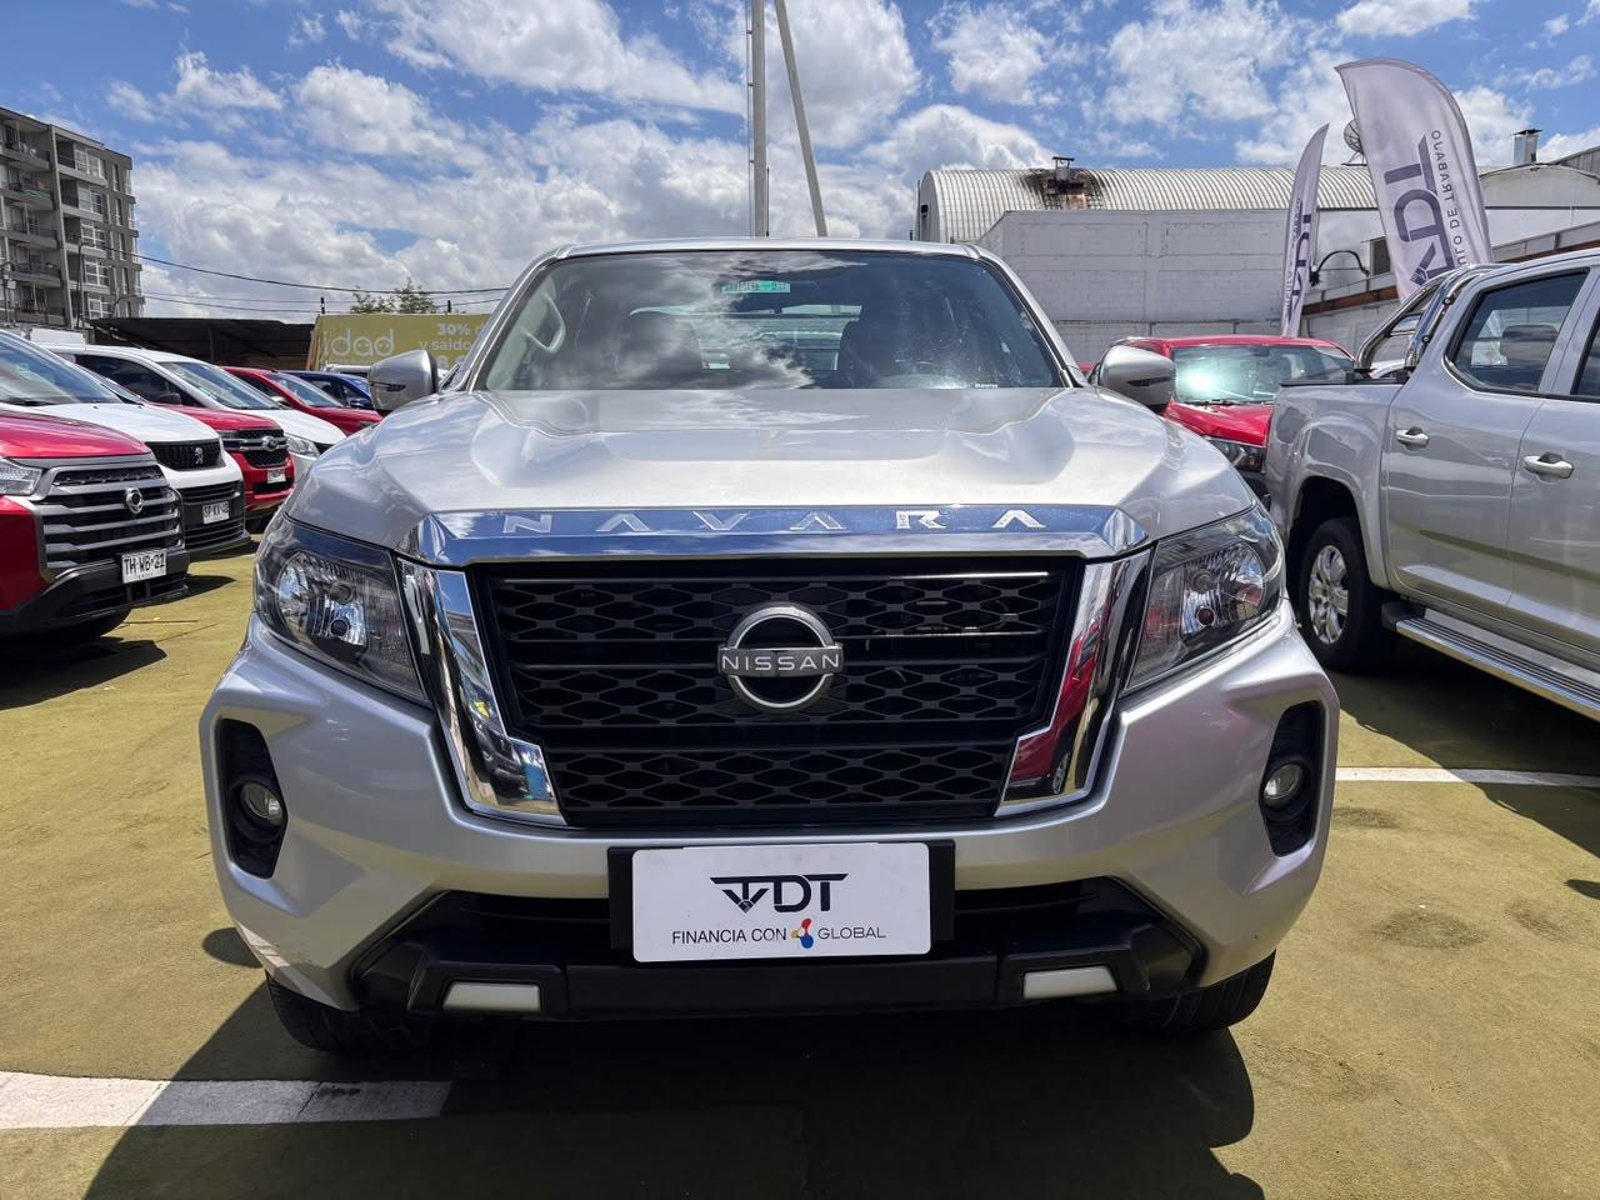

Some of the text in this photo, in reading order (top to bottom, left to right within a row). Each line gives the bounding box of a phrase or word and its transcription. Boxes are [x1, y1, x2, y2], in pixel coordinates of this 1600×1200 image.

[503, 509, 1046, 533] NAVARA
[722, 654, 839, 671] NISSAN
[672, 927, 886, 944] FINANCIA CON GLOBAL
